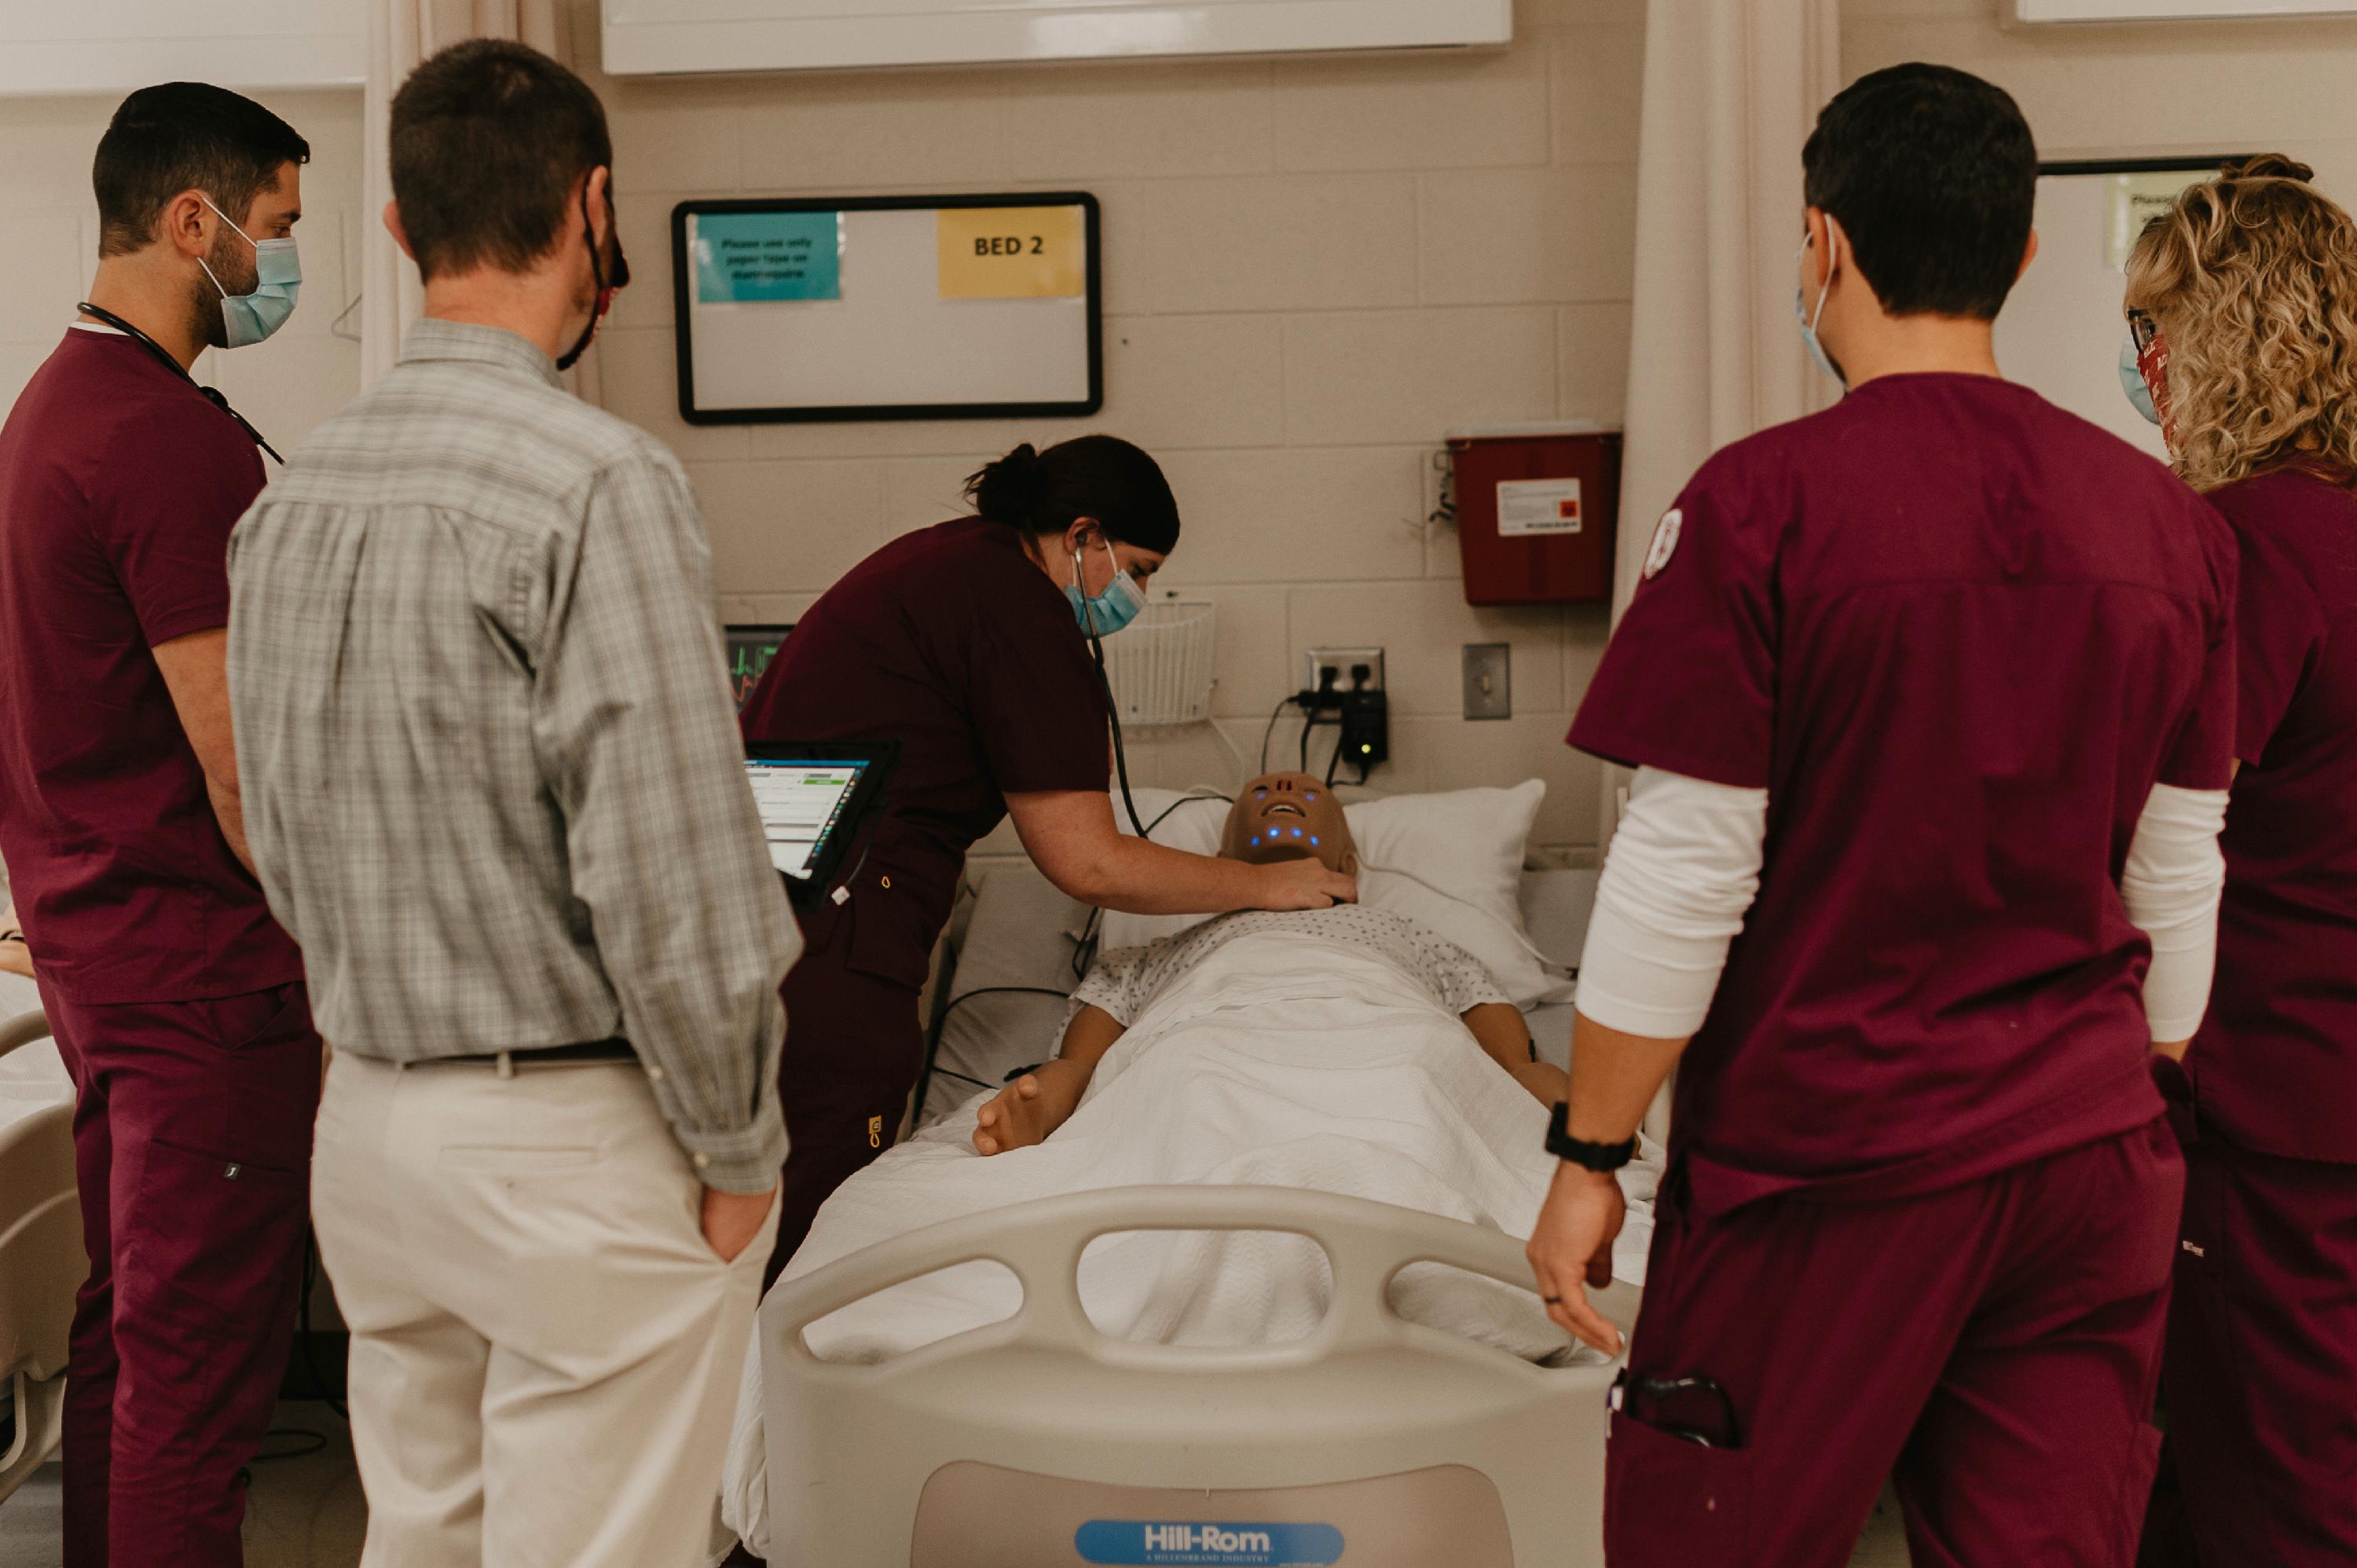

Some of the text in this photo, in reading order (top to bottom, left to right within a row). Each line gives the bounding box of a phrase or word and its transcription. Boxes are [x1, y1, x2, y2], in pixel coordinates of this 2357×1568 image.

[721, 237, 812, 249] Please use only
[974, 235, 1044, 256] BED 2
[1145, 1525, 1270, 1552] Hill-Rom
